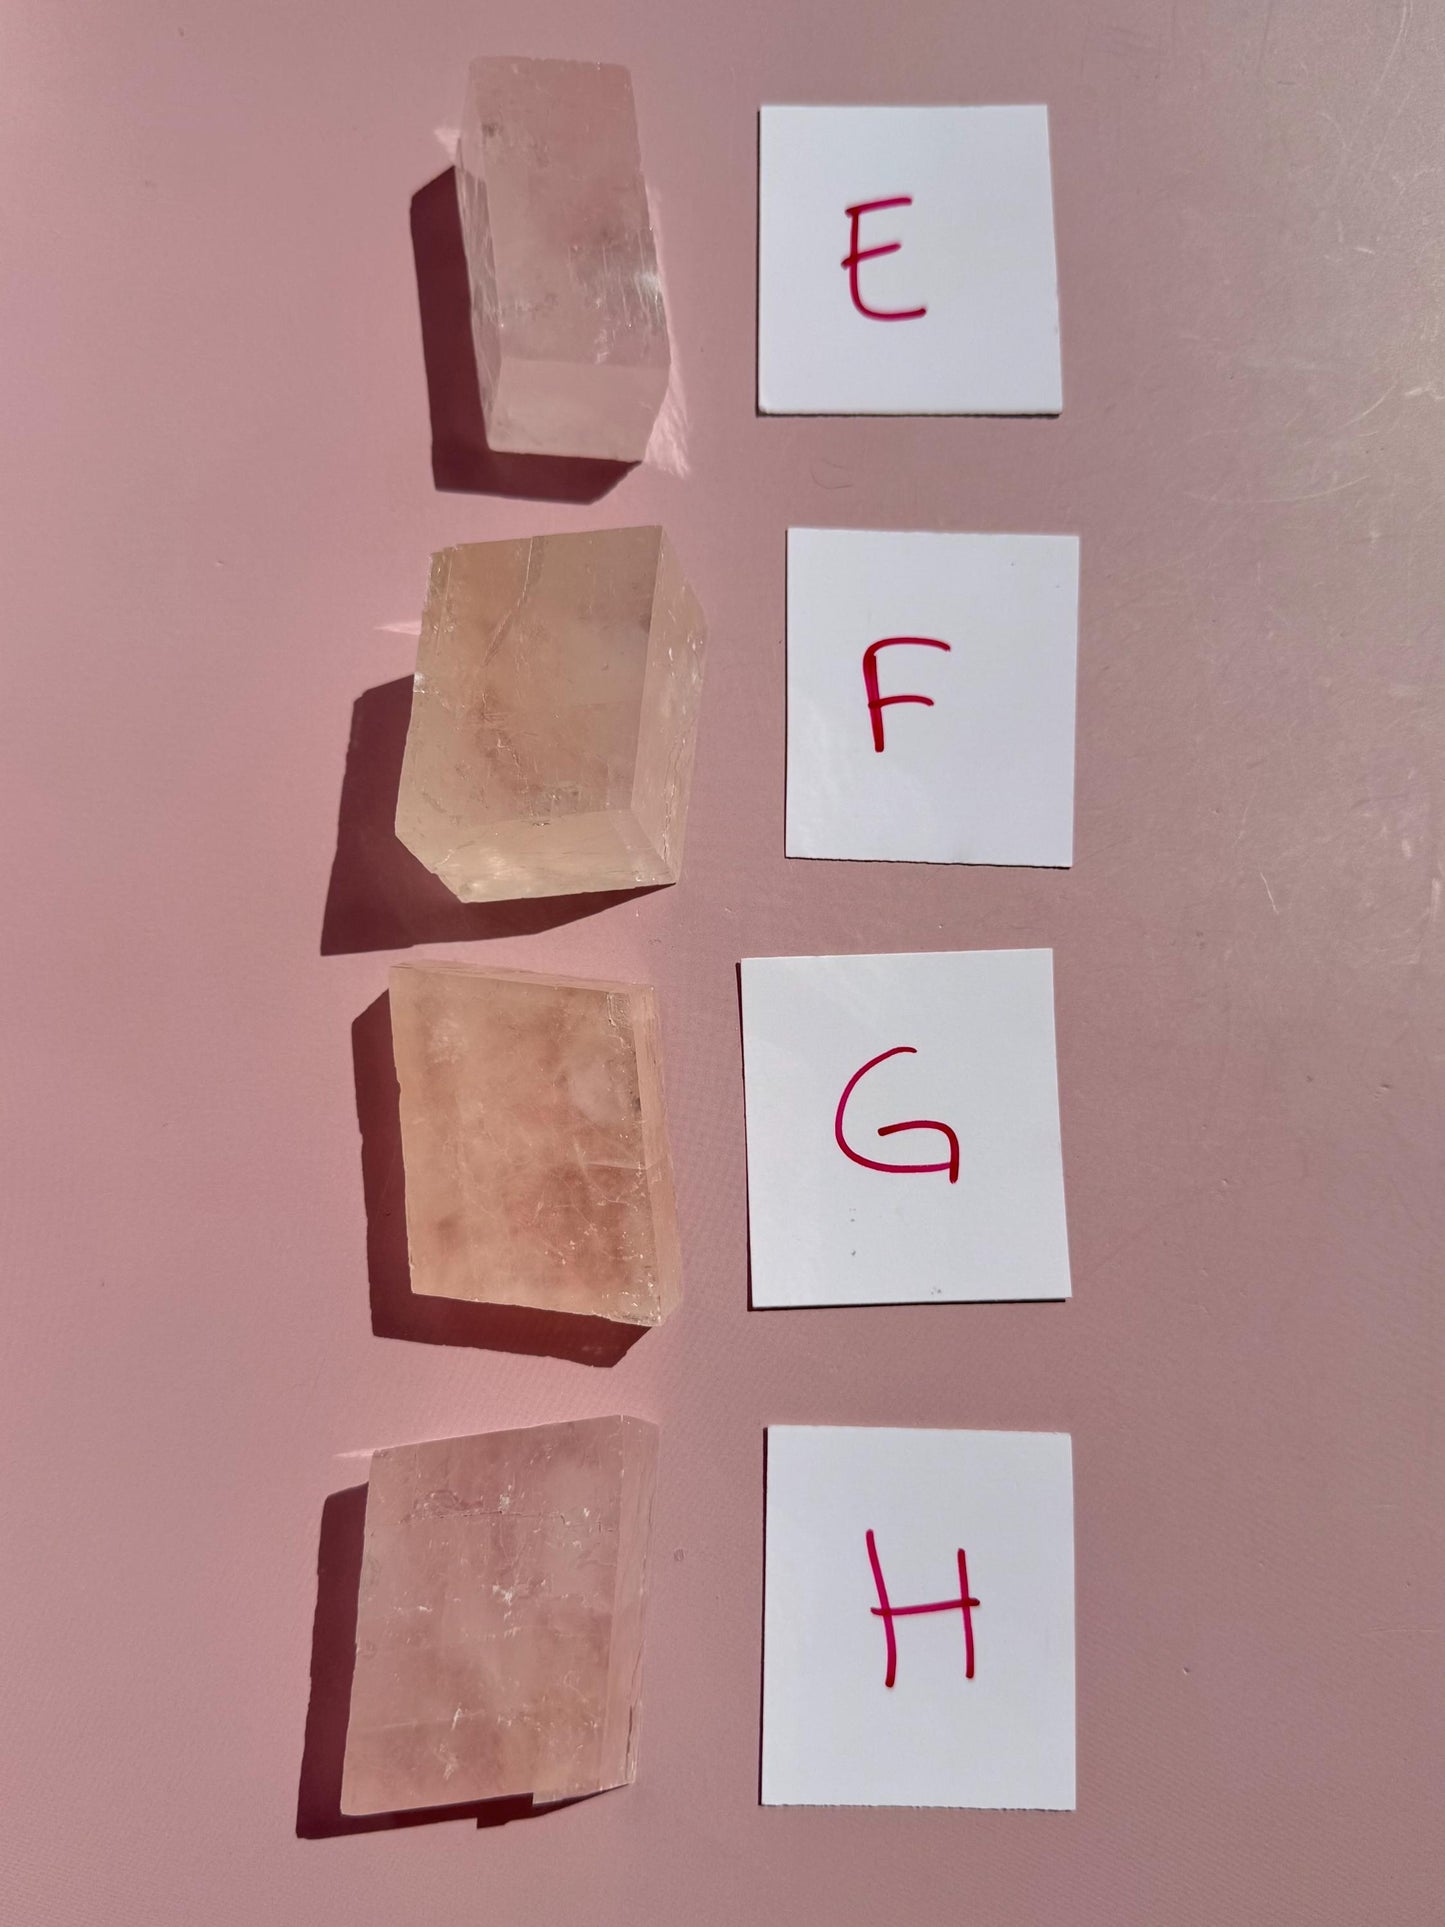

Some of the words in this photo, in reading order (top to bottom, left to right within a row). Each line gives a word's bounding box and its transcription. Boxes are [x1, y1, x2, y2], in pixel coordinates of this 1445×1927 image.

[841, 194, 927, 321] E
[862, 636, 952, 754] F
[834, 1045, 960, 1185] G
[866, 1528, 982, 1688] H
